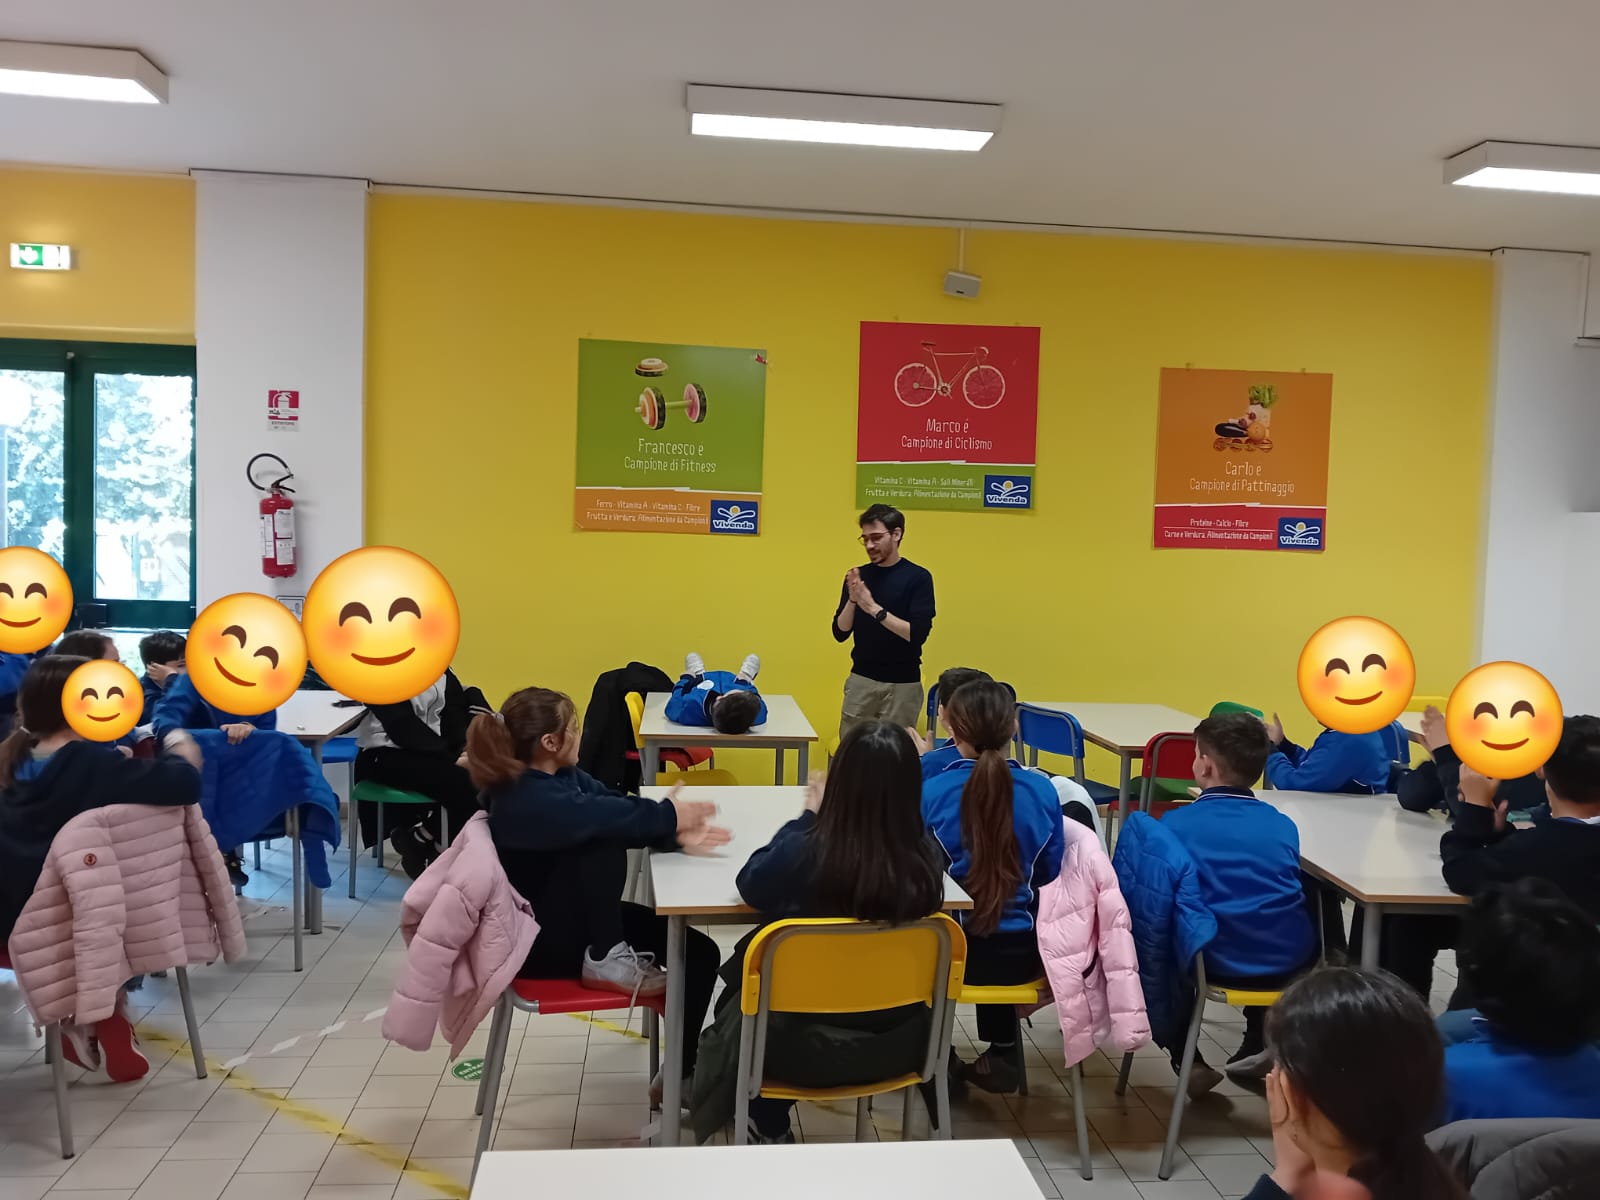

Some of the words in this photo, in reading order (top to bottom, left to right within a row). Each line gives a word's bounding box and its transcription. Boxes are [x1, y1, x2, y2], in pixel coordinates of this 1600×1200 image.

[926, 418, 960, 433] Marco
[638, 438, 695, 455] Francesco
[901, 435, 942, 452] Campione
[945, 437, 952, 448] di
[955, 437, 992, 450] Ciclismo
[624, 456, 668, 475] Campione
[670, 459, 678, 471] di
[681, 459, 717, 472] Fitness
[1226, 461, 1254, 476] Carlo
[874, 476, 898, 484] Vitamina
[866, 488, 885, 496] Frutta
[1190, 478, 1229, 494] Campione
[1232, 479, 1239, 490] di
[1242, 479, 1295, 496] Pattinaggio
[597, 499, 612, 508] Ferro
[617, 500, 642, 509] Vitamina
[653, 502, 676, 510] Vitamina
[586, 511, 608, 520] Frutta
[714, 520, 754, 529] Vivenda
[1281, 537, 1318, 545] Vivenda
